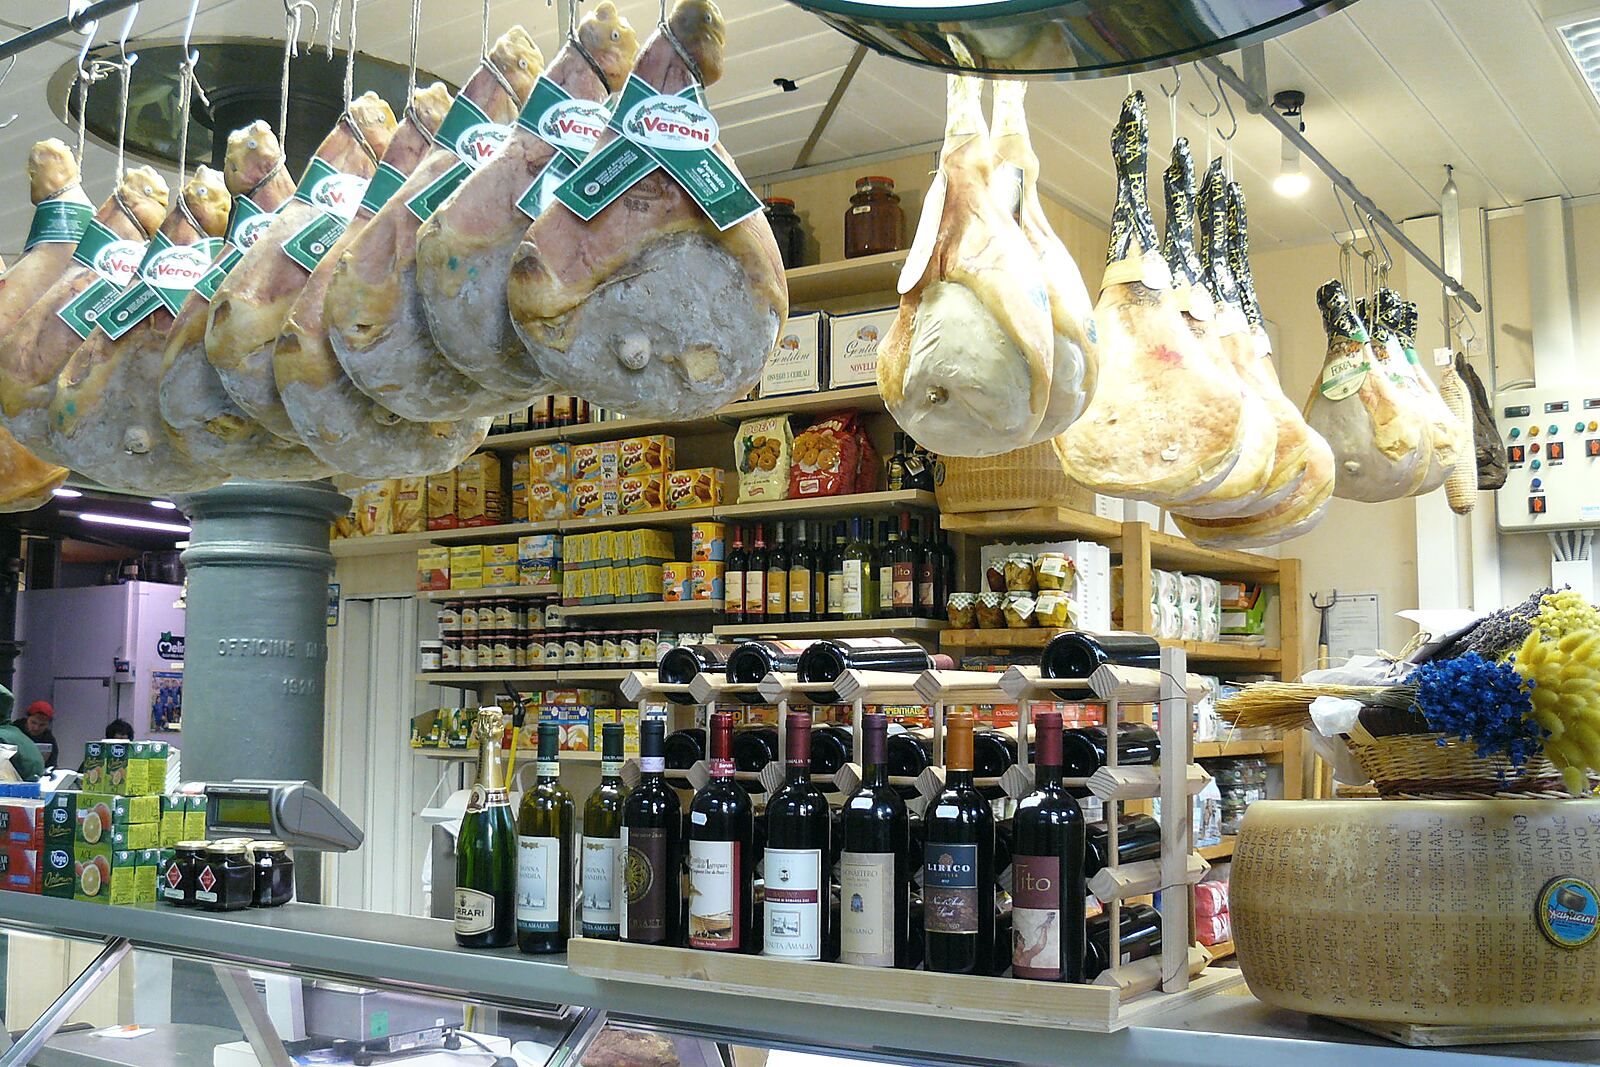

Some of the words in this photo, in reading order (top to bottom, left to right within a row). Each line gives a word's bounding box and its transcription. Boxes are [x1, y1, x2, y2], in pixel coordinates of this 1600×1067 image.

[559, 118, 602, 142] Vero
[643, 117, 710, 145] Veroni
[111, 258, 138, 276] Ver
[157, 263, 202, 283] Veron
[843, 340, 878, 358] Gentil
[534, 448, 550, 458] ORO
[576, 448, 593, 457] ORO
[623, 443, 643, 453] ORO
[623, 480, 643, 491] ORO
[671, 476, 692, 486] ORO
[534, 486, 550, 495] ORO
[576, 485, 594, 494] ORO
[159, 641, 185, 654] Melin
[1552, 815, 1576, 876] MIGIANO
[927, 863, 971, 874] LIRICO
[1016, 864, 1051, 893] Tito
[456, 907, 485, 917] RRARI
[786, 942, 813, 951] AMALIA
